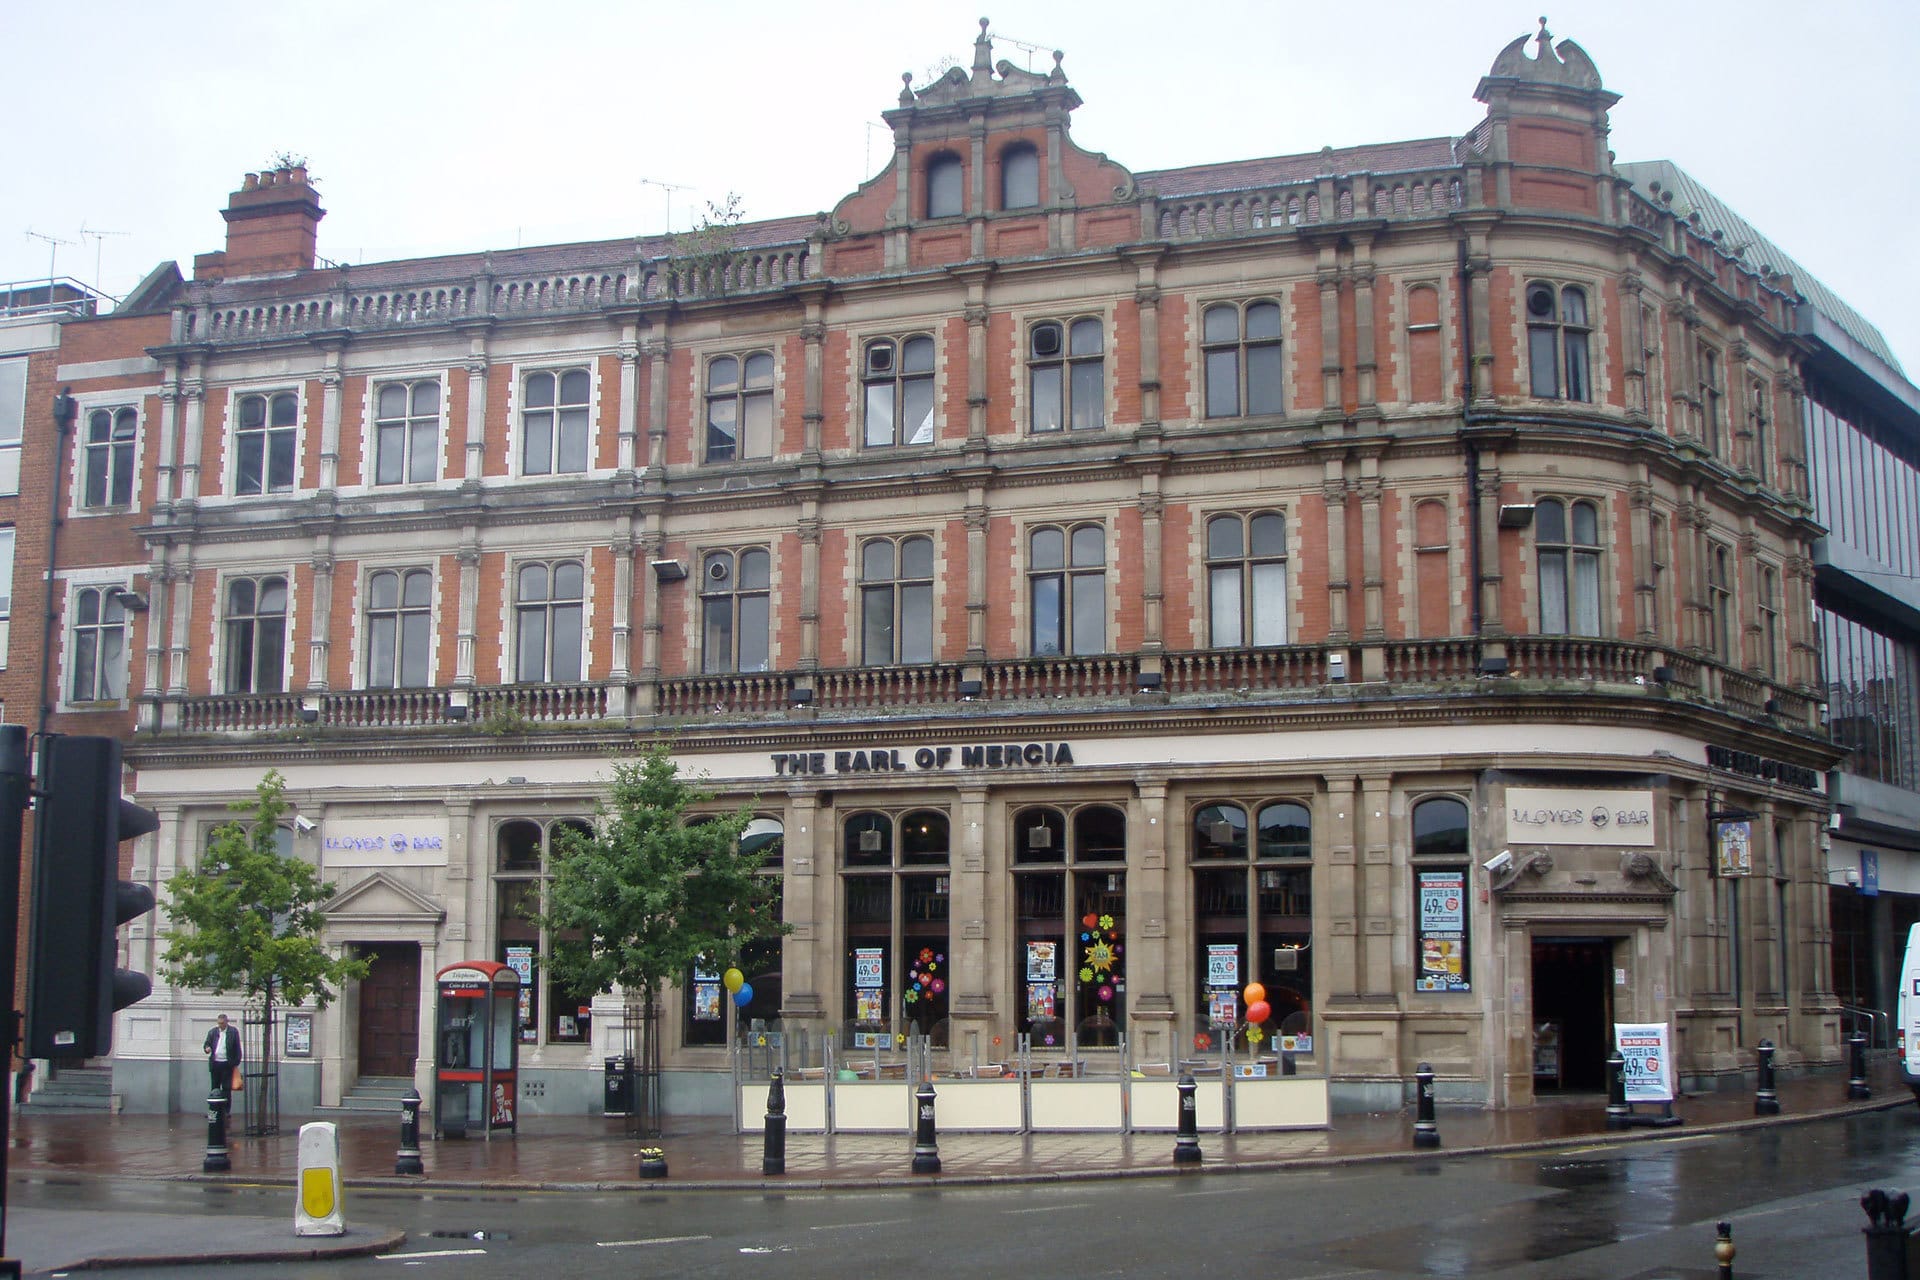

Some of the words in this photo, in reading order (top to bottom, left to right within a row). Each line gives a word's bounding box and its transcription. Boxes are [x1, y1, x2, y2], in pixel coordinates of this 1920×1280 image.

[771, 753, 825, 777] THE
[833, 750, 906, 774] EARL
[914, 747, 952, 769] OF
[961, 742, 1074, 767] MERCIA
[1616, 809, 1649, 826] BAR
[413, 836, 443, 850] BAR
[1424, 889, 1443, 897] COFFEE
[1450, 889, 1459, 897] TEA
[1424, 898, 1443, 915] 49p
[1623, 1047, 1643, 1057] COFFEE
[1643, 1048, 1648, 1057] &
[1648, 1048, 1659, 1057] TEA
[1625, 1057, 1644, 1077] 49p
